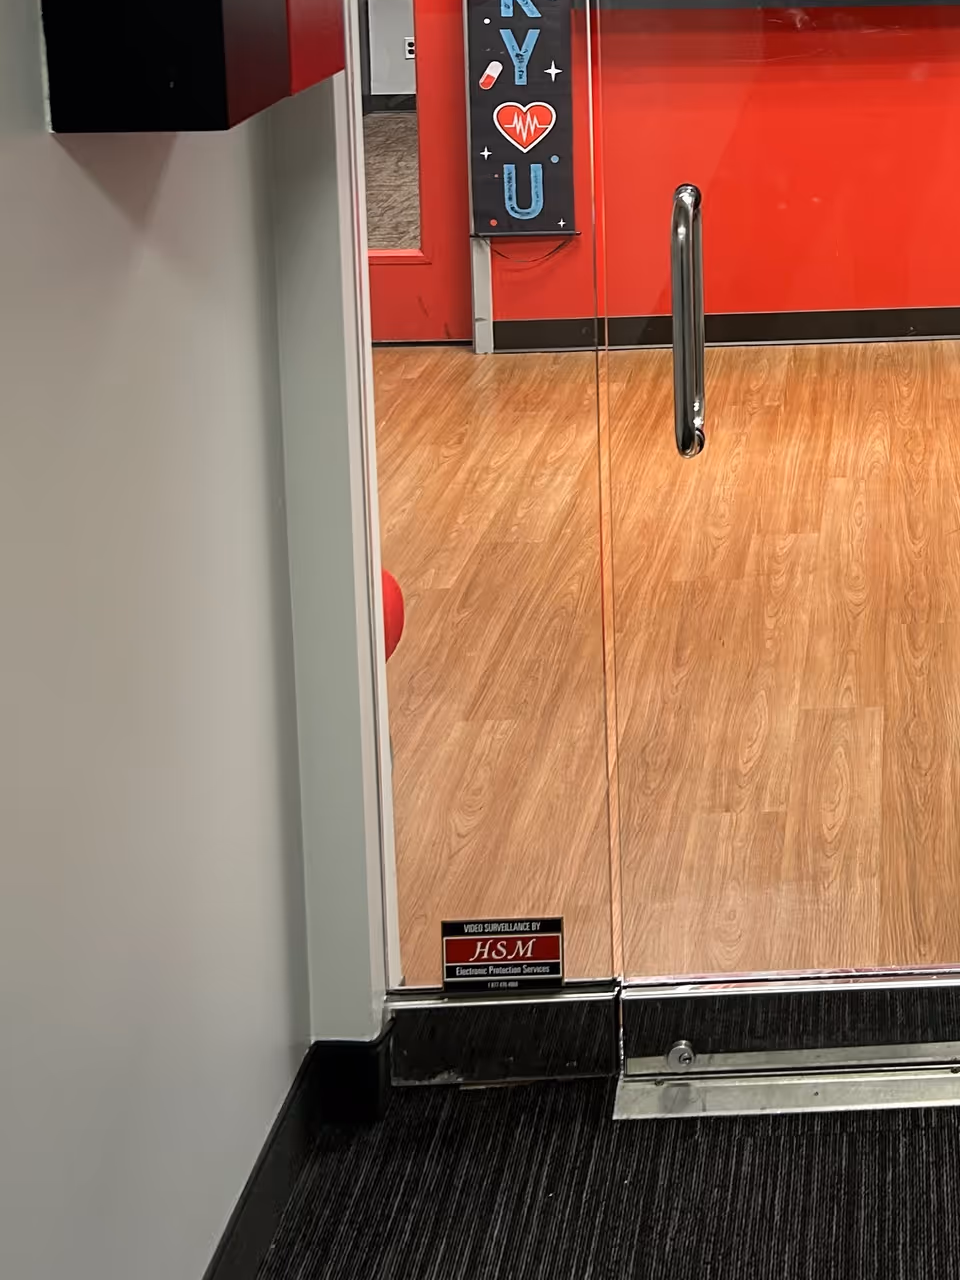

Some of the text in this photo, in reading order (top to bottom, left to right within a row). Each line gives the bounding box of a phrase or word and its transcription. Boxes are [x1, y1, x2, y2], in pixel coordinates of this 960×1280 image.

[463, 921, 541, 933] VIDEO SURVEILLANCE BY
[469, 938, 536, 961] HSM
[455, 964, 550, 976] Electronic Protection Services
